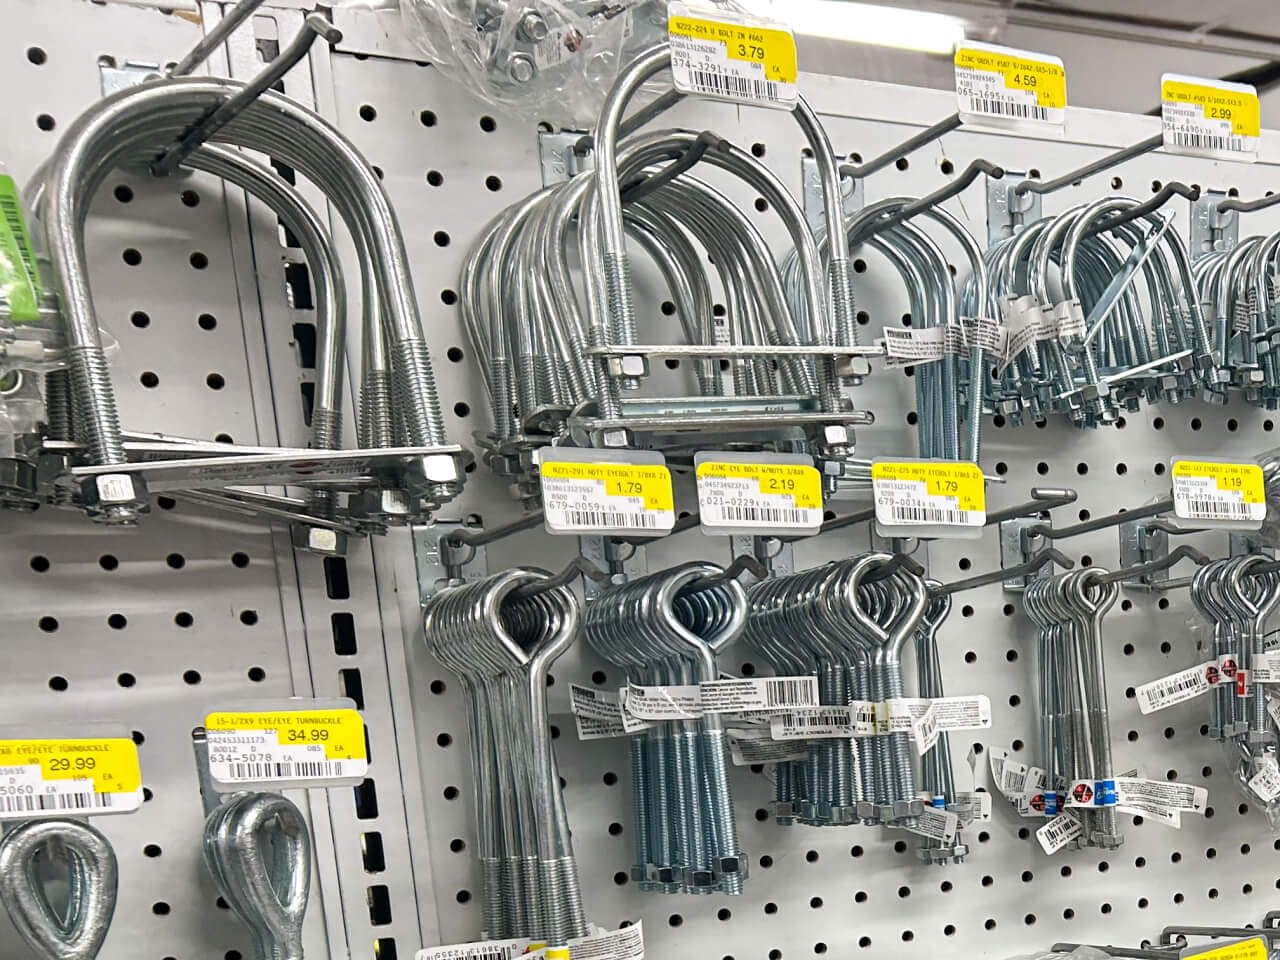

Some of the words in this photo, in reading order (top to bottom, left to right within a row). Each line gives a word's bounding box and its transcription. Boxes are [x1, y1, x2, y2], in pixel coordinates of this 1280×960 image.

[738, 45, 764, 59] 3.79
[672, 57, 721, 72] 374-3291
[1013, 73, 1037, 86] 4.59
[1211, 107, 1231, 119] 2.99
[616, 482, 642, 494] 1.79
[769, 479, 794, 490] 2.19
[935, 481, 958, 492] 1.79
[1223, 477, 1241, 487] 1.19
[287, 729, 328, 741] 34.99
[50, 757, 96, 770] 29.99
[209, 754, 272, 762] 634-5078
